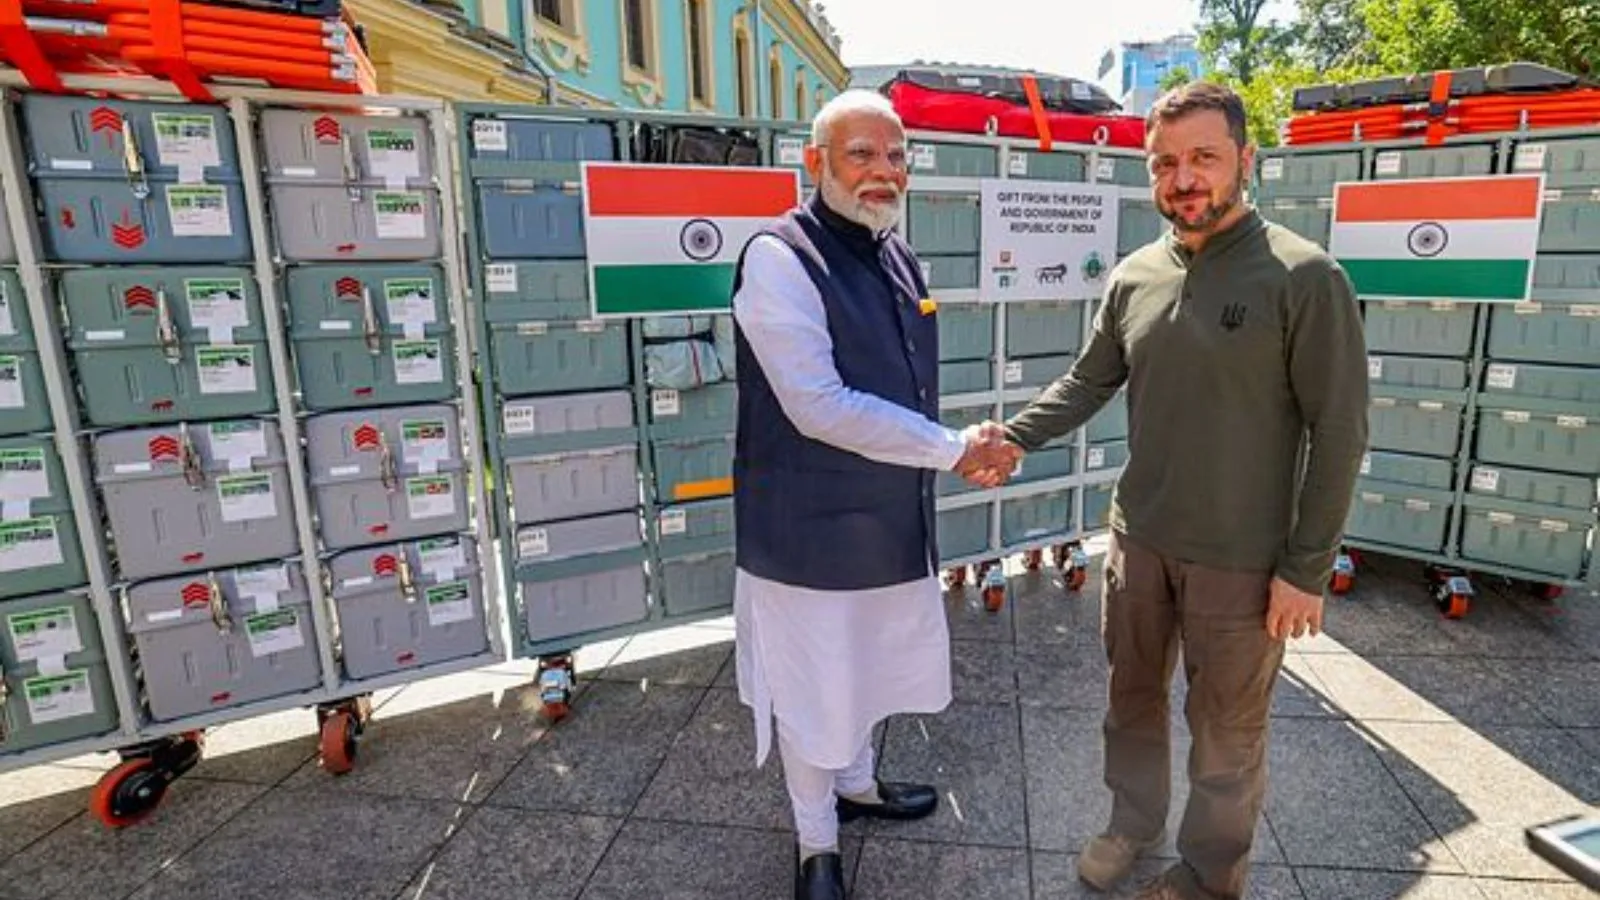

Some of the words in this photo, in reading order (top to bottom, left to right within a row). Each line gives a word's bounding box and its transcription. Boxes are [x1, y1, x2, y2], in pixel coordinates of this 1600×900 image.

[997, 192, 1019, 202] GIFT
[1021, 193, 1050, 204] FROM
[1053, 194, 1068, 204] THE
[1071, 195, 1102, 206] PEOPLE
[1000, 207, 1022, 218] AND
[1024, 208, 1088, 220] GOVERNMENT
[1090, 210, 1102, 220] OF
[1010, 222, 1054, 233] REPUBLIC
[1056, 223, 1069, 233] OF
[1071, 223, 1096, 233] INDIA
